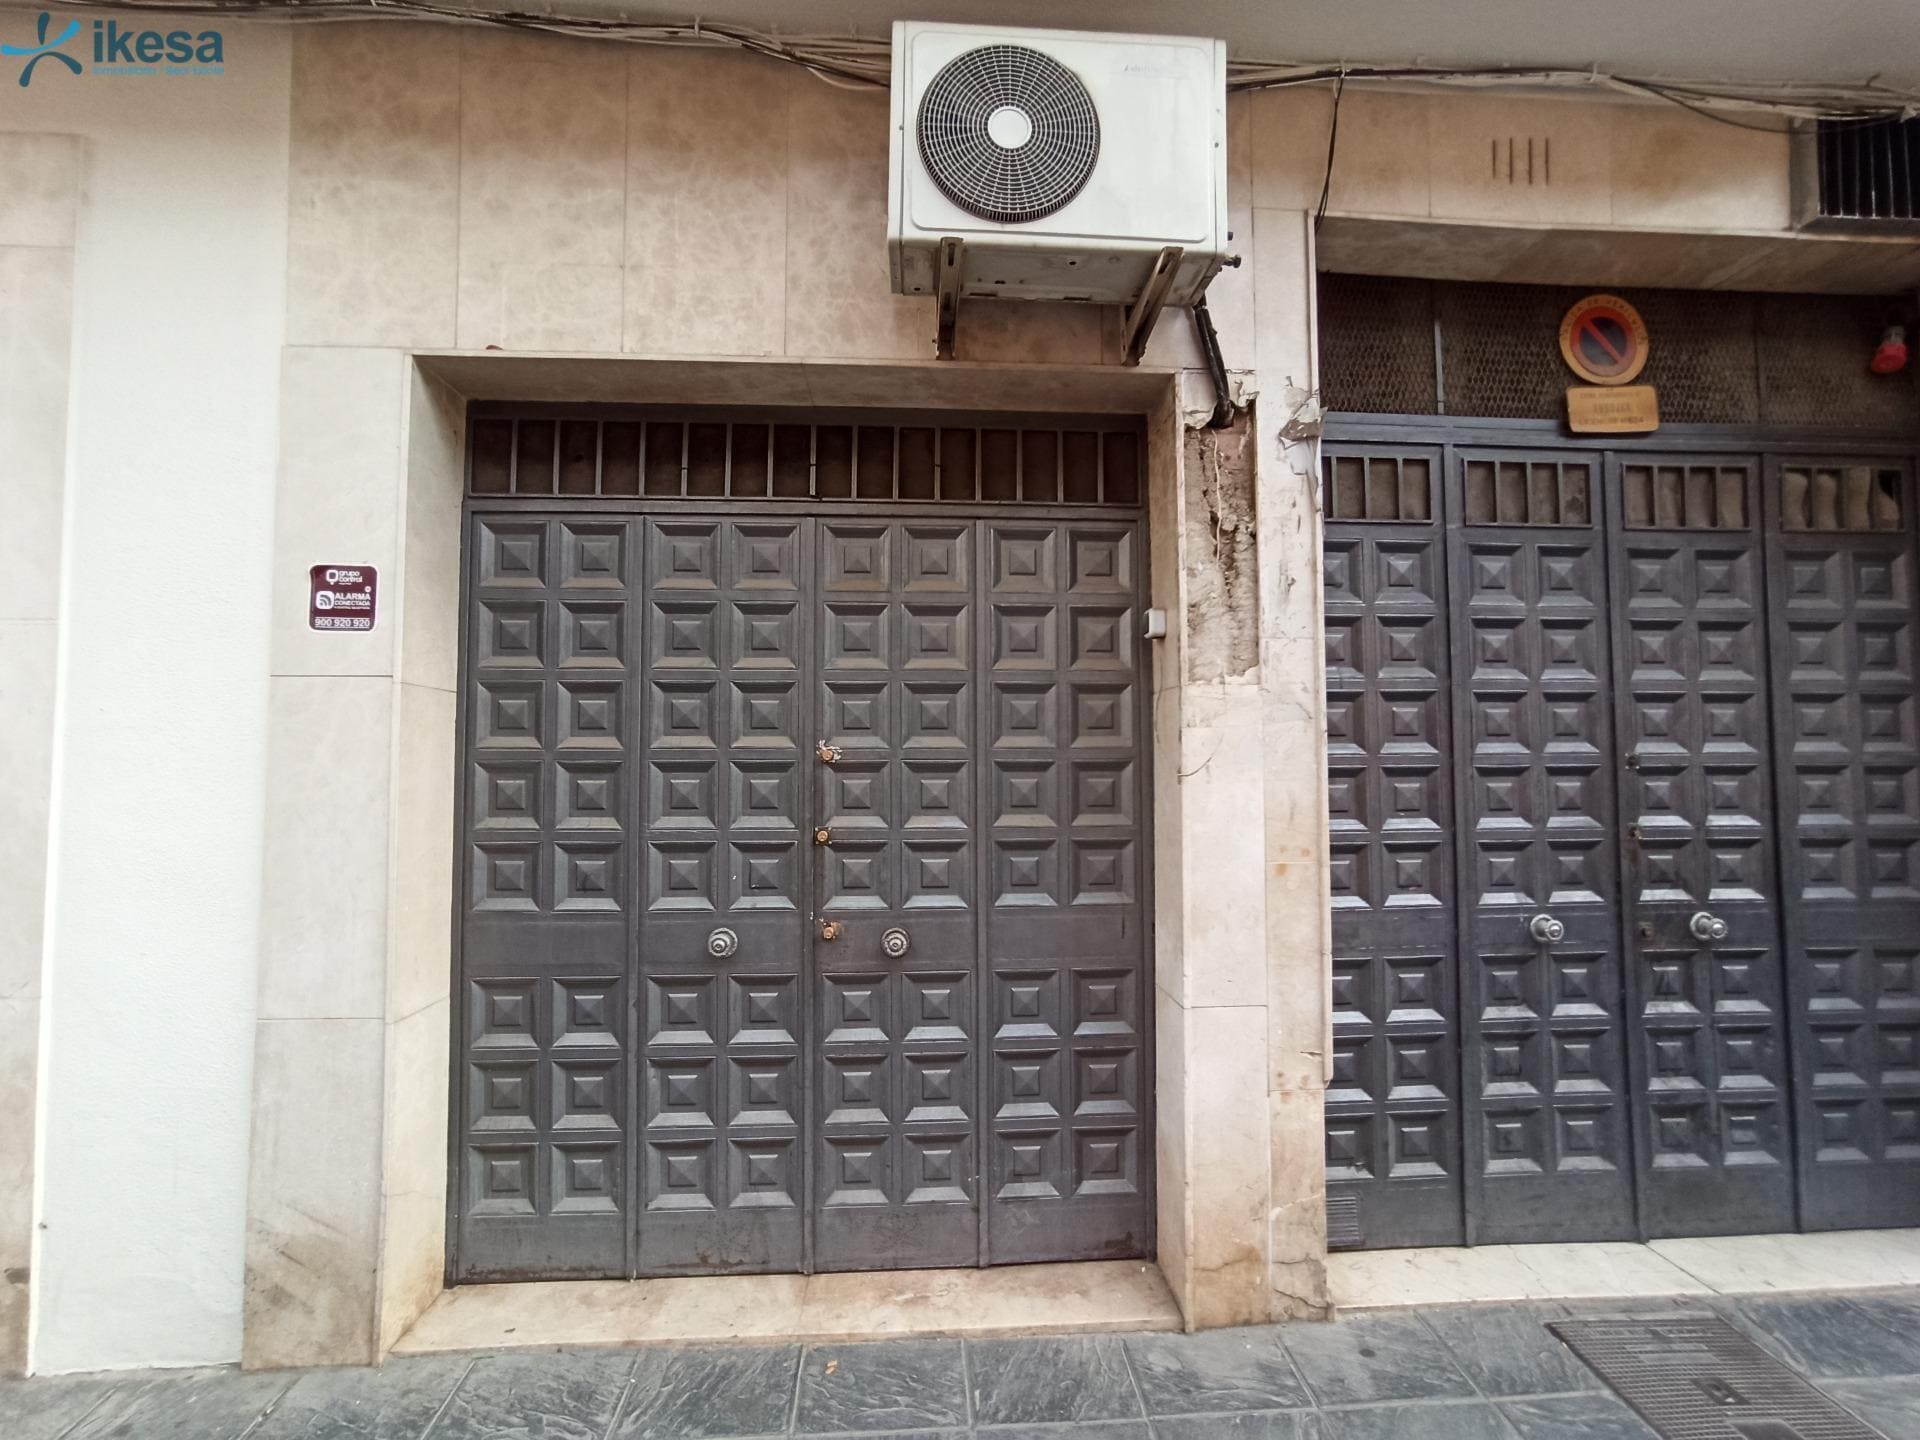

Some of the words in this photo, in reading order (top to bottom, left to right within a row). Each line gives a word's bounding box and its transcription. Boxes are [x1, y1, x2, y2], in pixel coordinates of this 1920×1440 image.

[335, 592, 371, 600] ALARMA
[314, 618, 333, 626] 900
[334, 618, 352, 627] 920
[353, 618, 370, 627] 920
